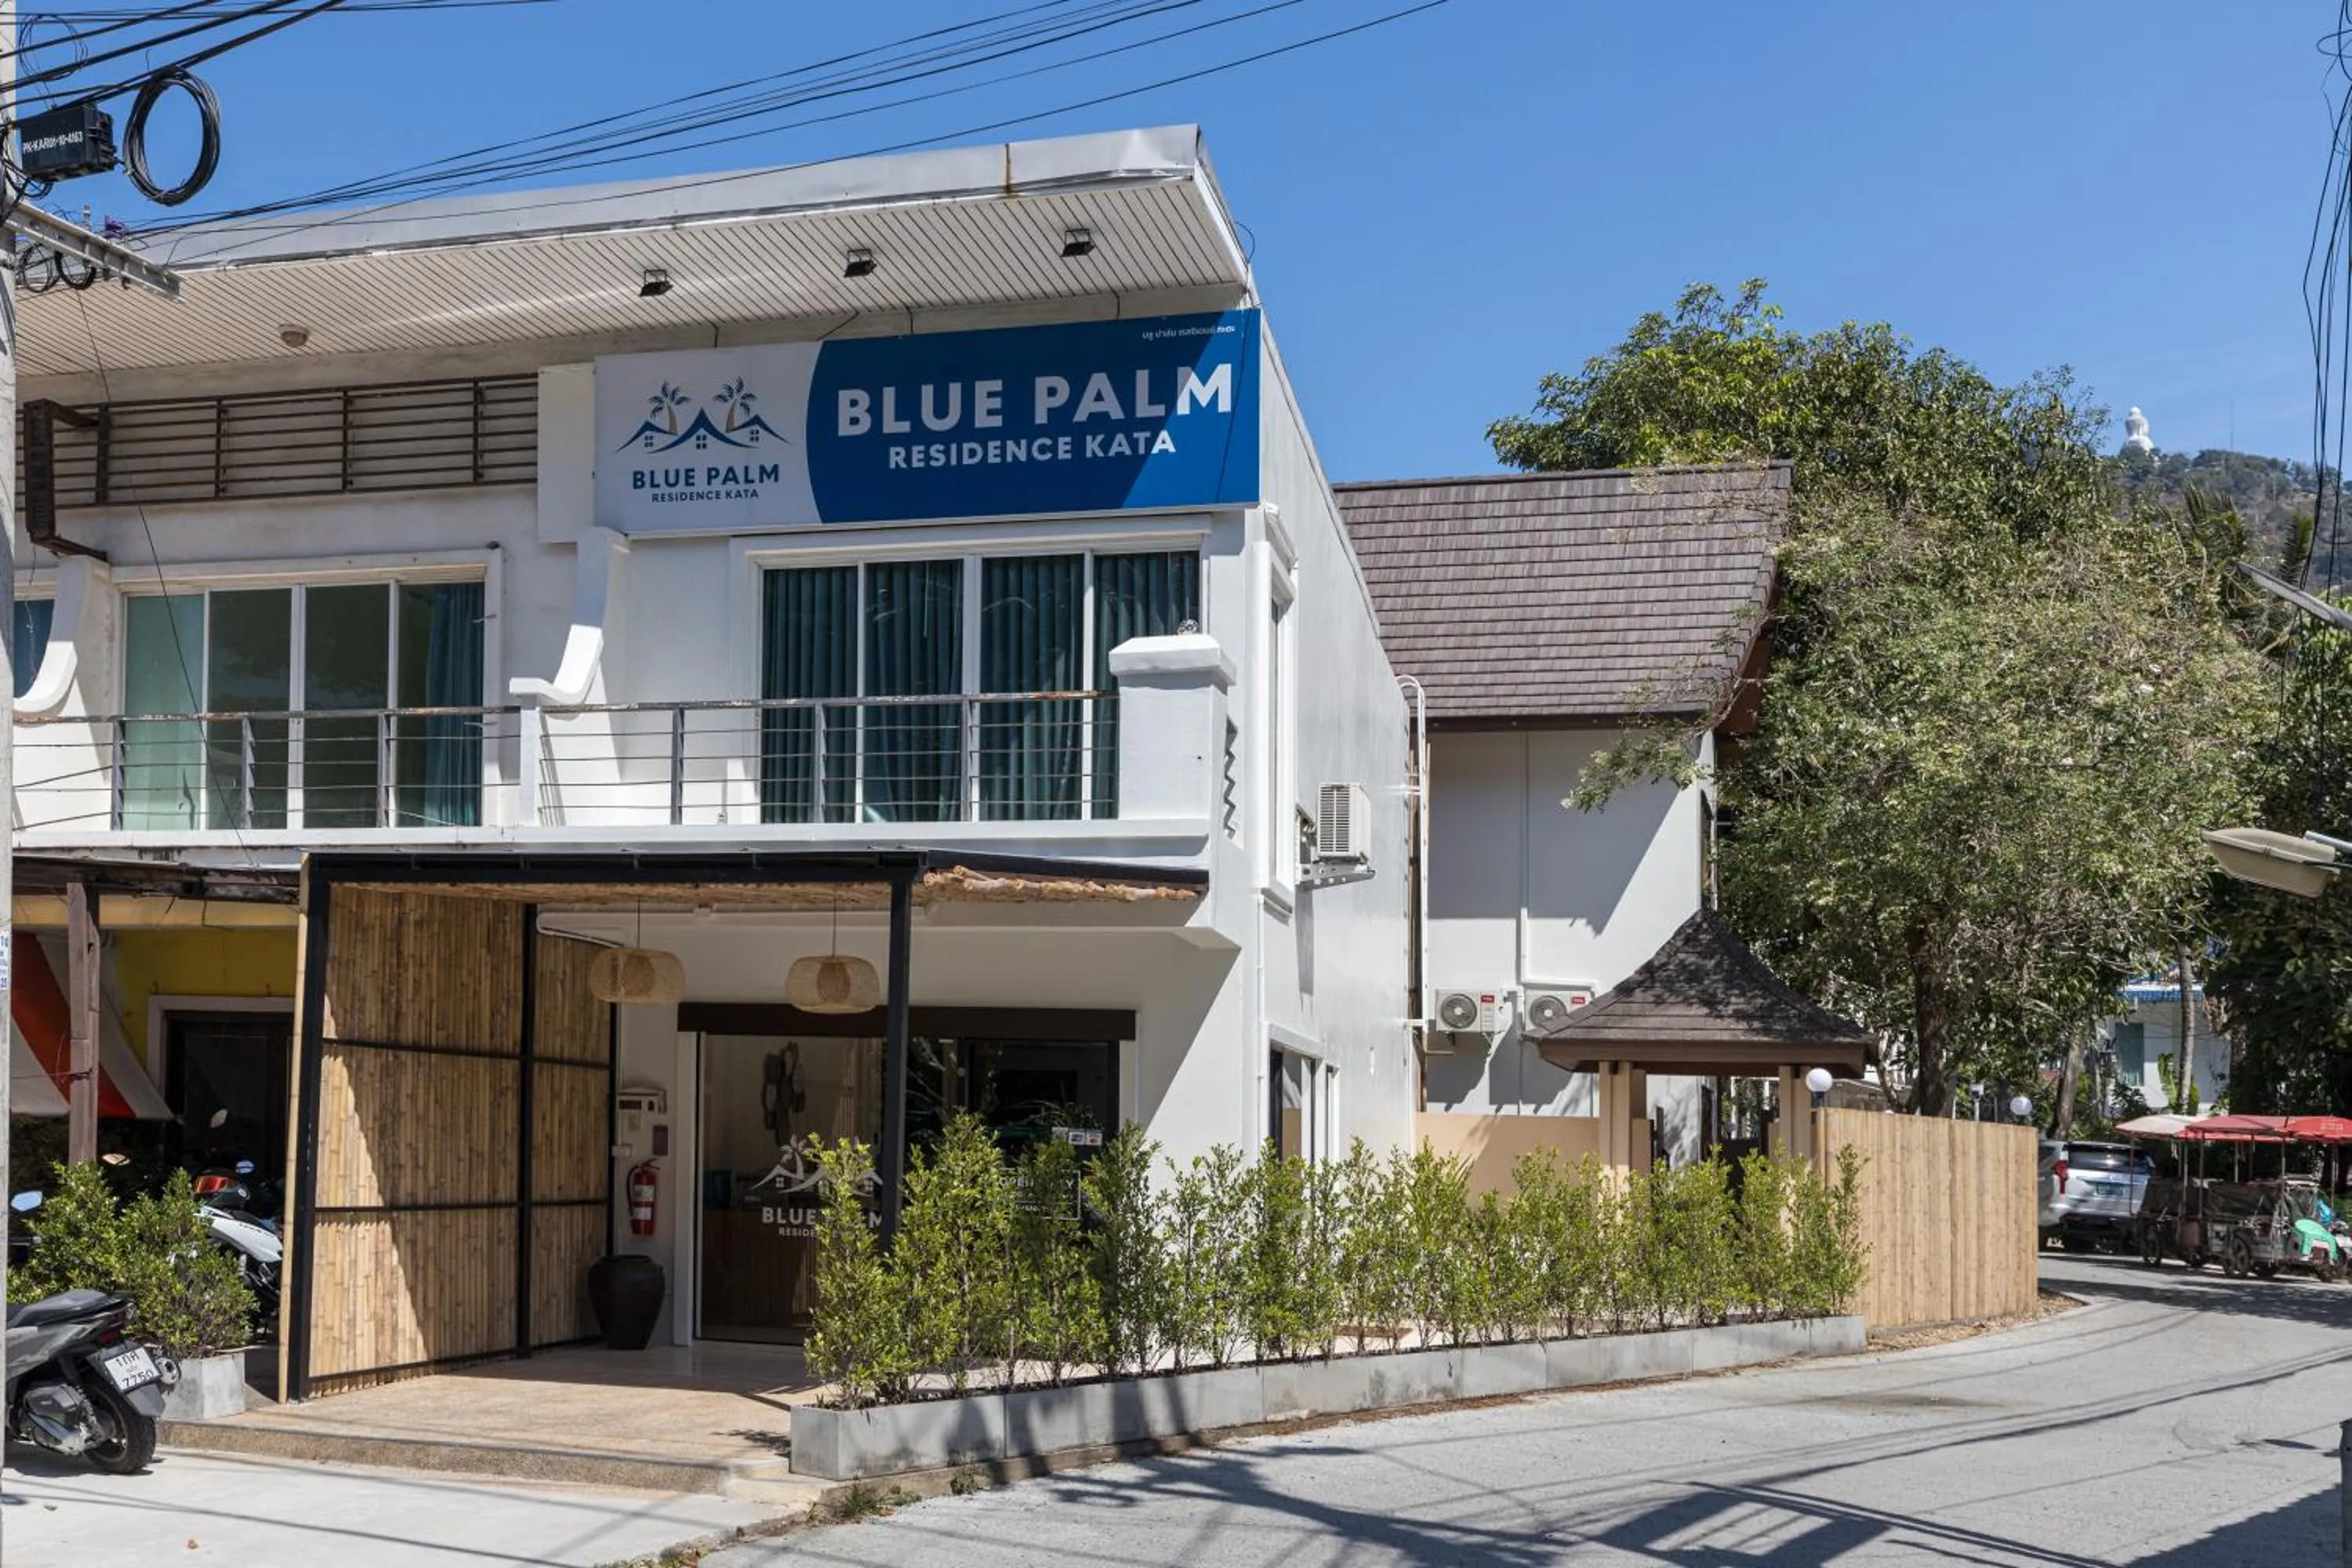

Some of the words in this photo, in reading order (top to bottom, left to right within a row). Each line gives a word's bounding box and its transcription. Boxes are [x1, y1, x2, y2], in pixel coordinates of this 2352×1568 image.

[838, 379, 1004, 437] BLUE
[1034, 363, 1232, 425] PALM
[888, 436, 1073, 469] RESIDENCE
[1085, 429, 1177, 458] KATA
[632, 467, 695, 490] BLUE
[706, 463, 780, 486] PALM
[652, 490, 722, 503] RESIDENCE
[725, 488, 760, 500] KATA
[762, 1207, 816, 1225] BLUE
